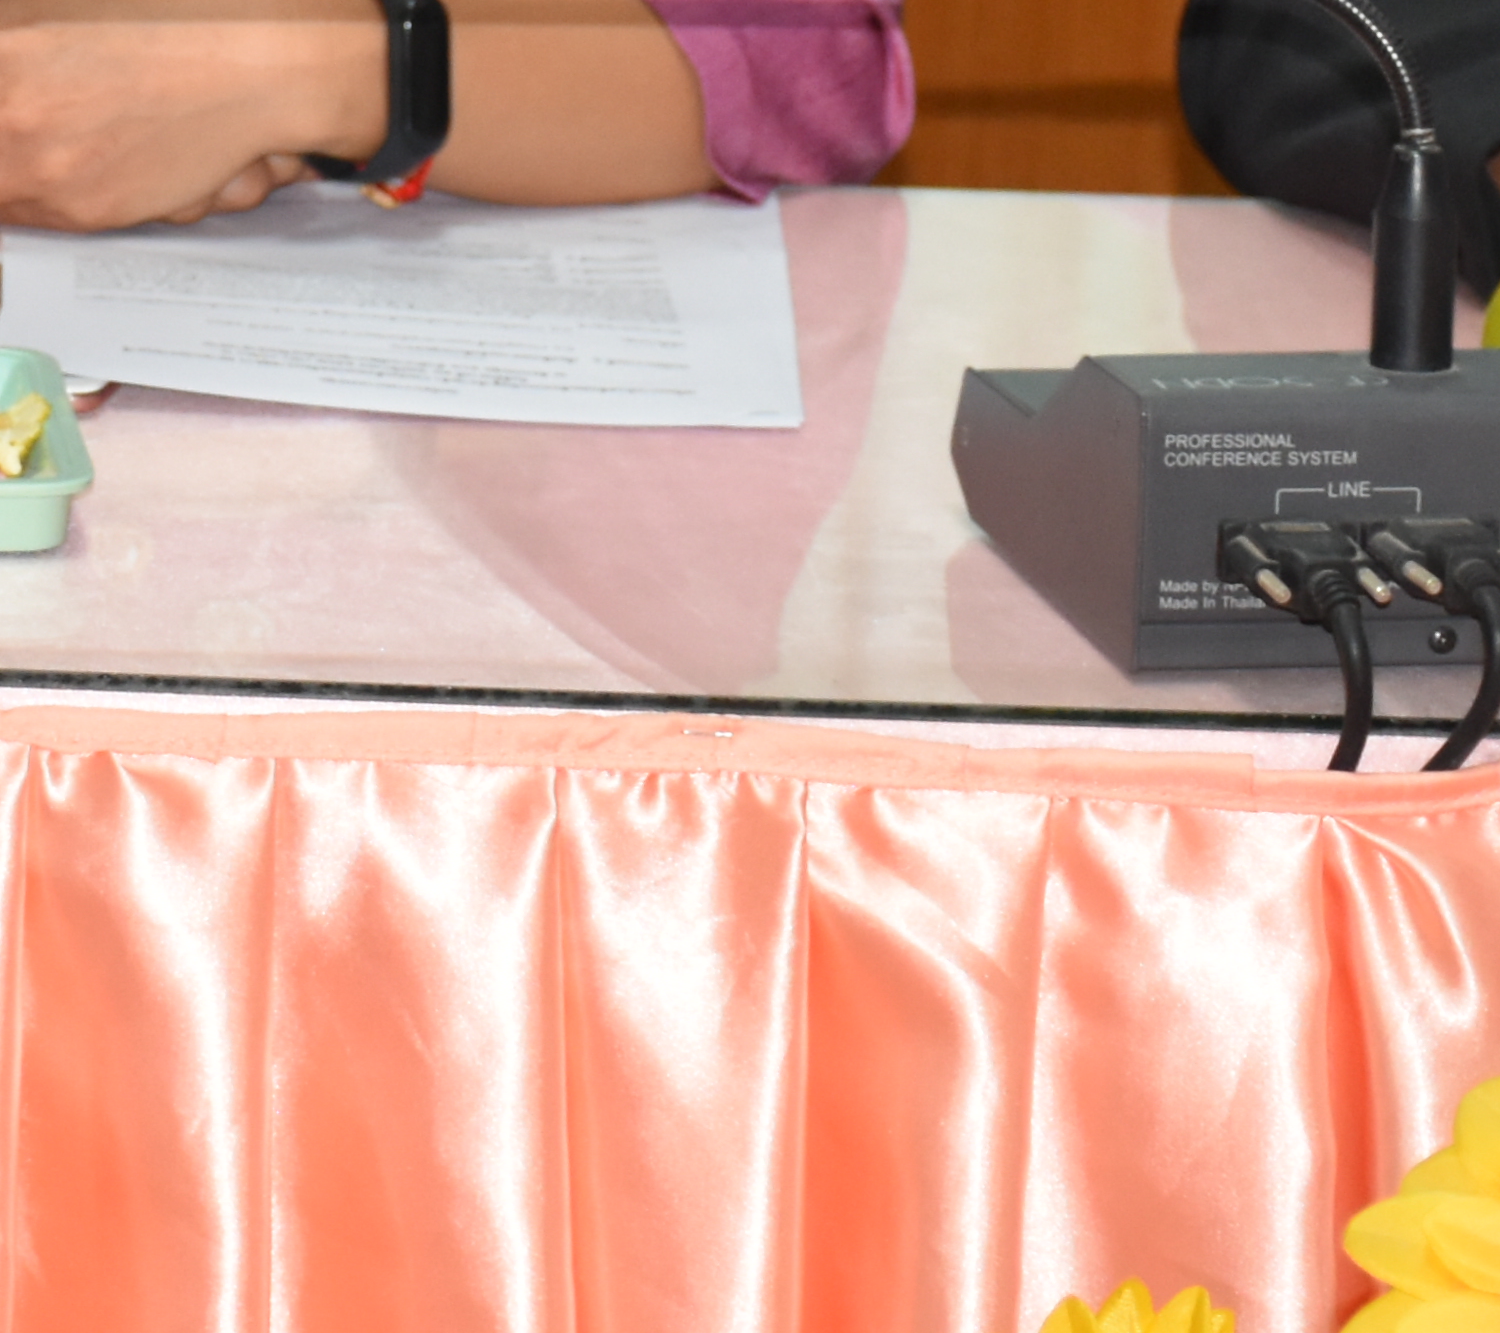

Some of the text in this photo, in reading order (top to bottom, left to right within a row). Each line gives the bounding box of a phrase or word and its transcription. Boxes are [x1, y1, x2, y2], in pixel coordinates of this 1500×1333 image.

[1164, 434, 1296, 449] PROFESSIONAL
[1164, 450, 1358, 467] CONFERENCE SYSTEM
[1327, 481, 1372, 498] LINE
[1159, 580, 1198, 593] Made
[1202, 580, 1219, 596] by
[1159, 596, 1198, 609] Made
[1203, 596, 1216, 608] In
